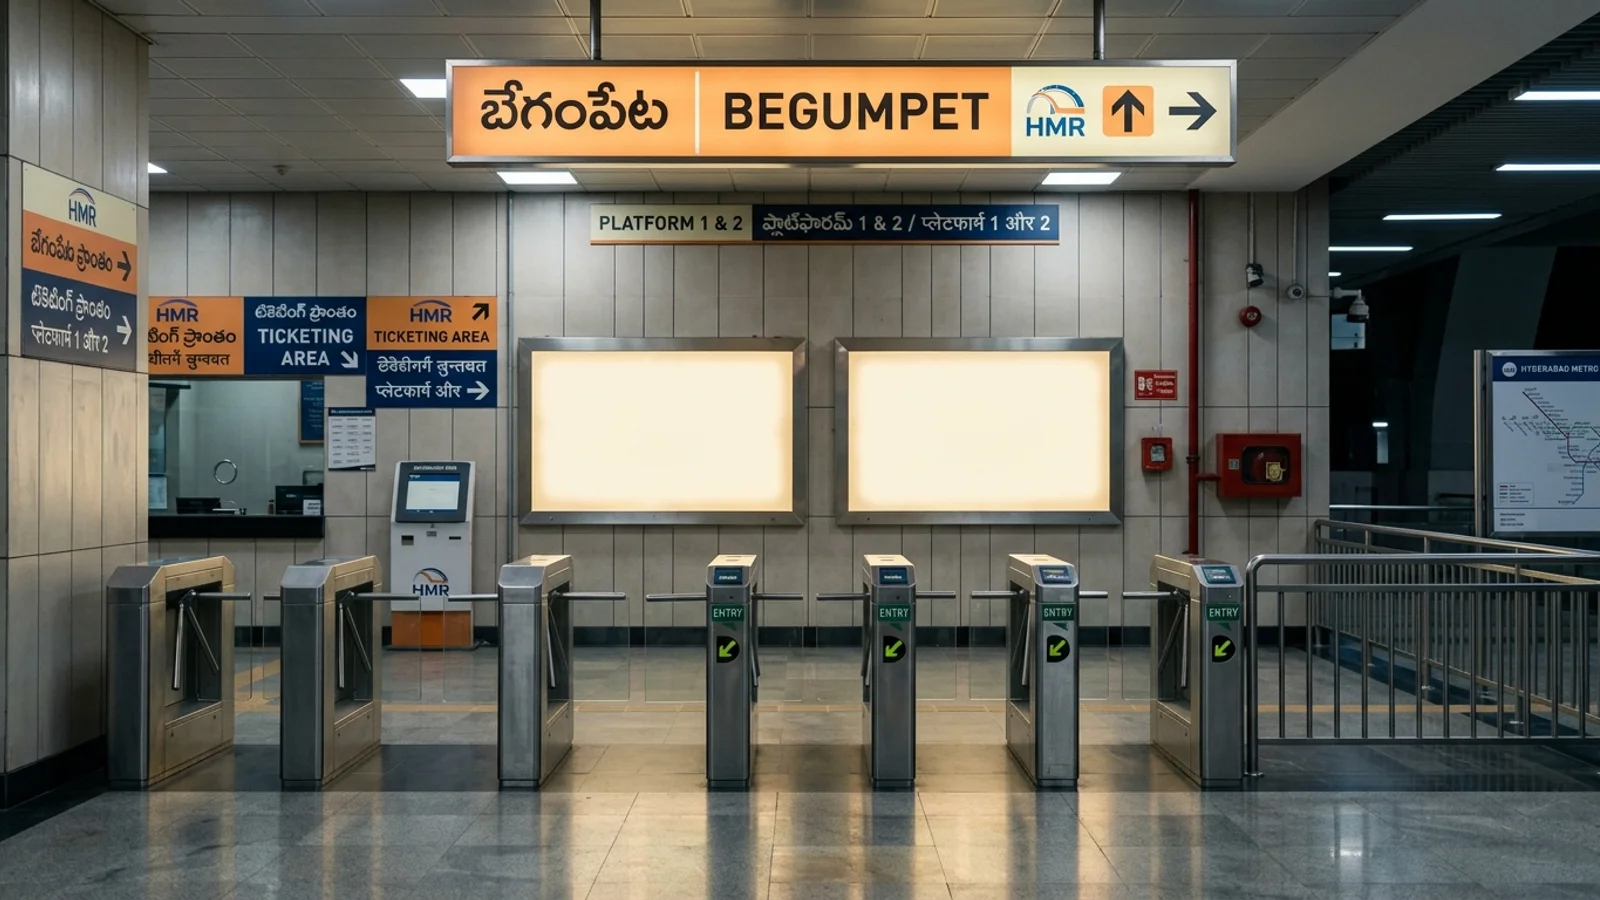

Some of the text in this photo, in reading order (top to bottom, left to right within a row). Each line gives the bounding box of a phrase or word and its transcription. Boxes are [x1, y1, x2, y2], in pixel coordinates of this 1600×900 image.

[481, 80, 668, 131] బేగంపేట
[724, 92, 990, 130] BEGUMPET
[1026, 116, 1085, 137] HMR
[68, 198, 97, 228] HMR
[859, 215, 867, 231] 1
[874, 215, 887, 231] &
[892, 215, 902, 231] 2
[907, 214, 917, 232] /
[990, 215, 998, 231] 1
[1005, 211, 1035, 231] और
[1040, 215, 1051, 231] 2
[599, 215, 743, 232] PLATFORM 1 & 2
[156, 307, 199, 323] HMR
[409, 307, 452, 323] HMR
[74, 332, 80, 350] 1
[102, 336, 109, 354] 2
[257, 328, 354, 345] TICKETING
[374, 330, 490, 343] TICKETING AREA
[281, 350, 330, 366] AREA
[412, 583, 449, 596] HMR
[879, 608, 909, 618] ENTRY
